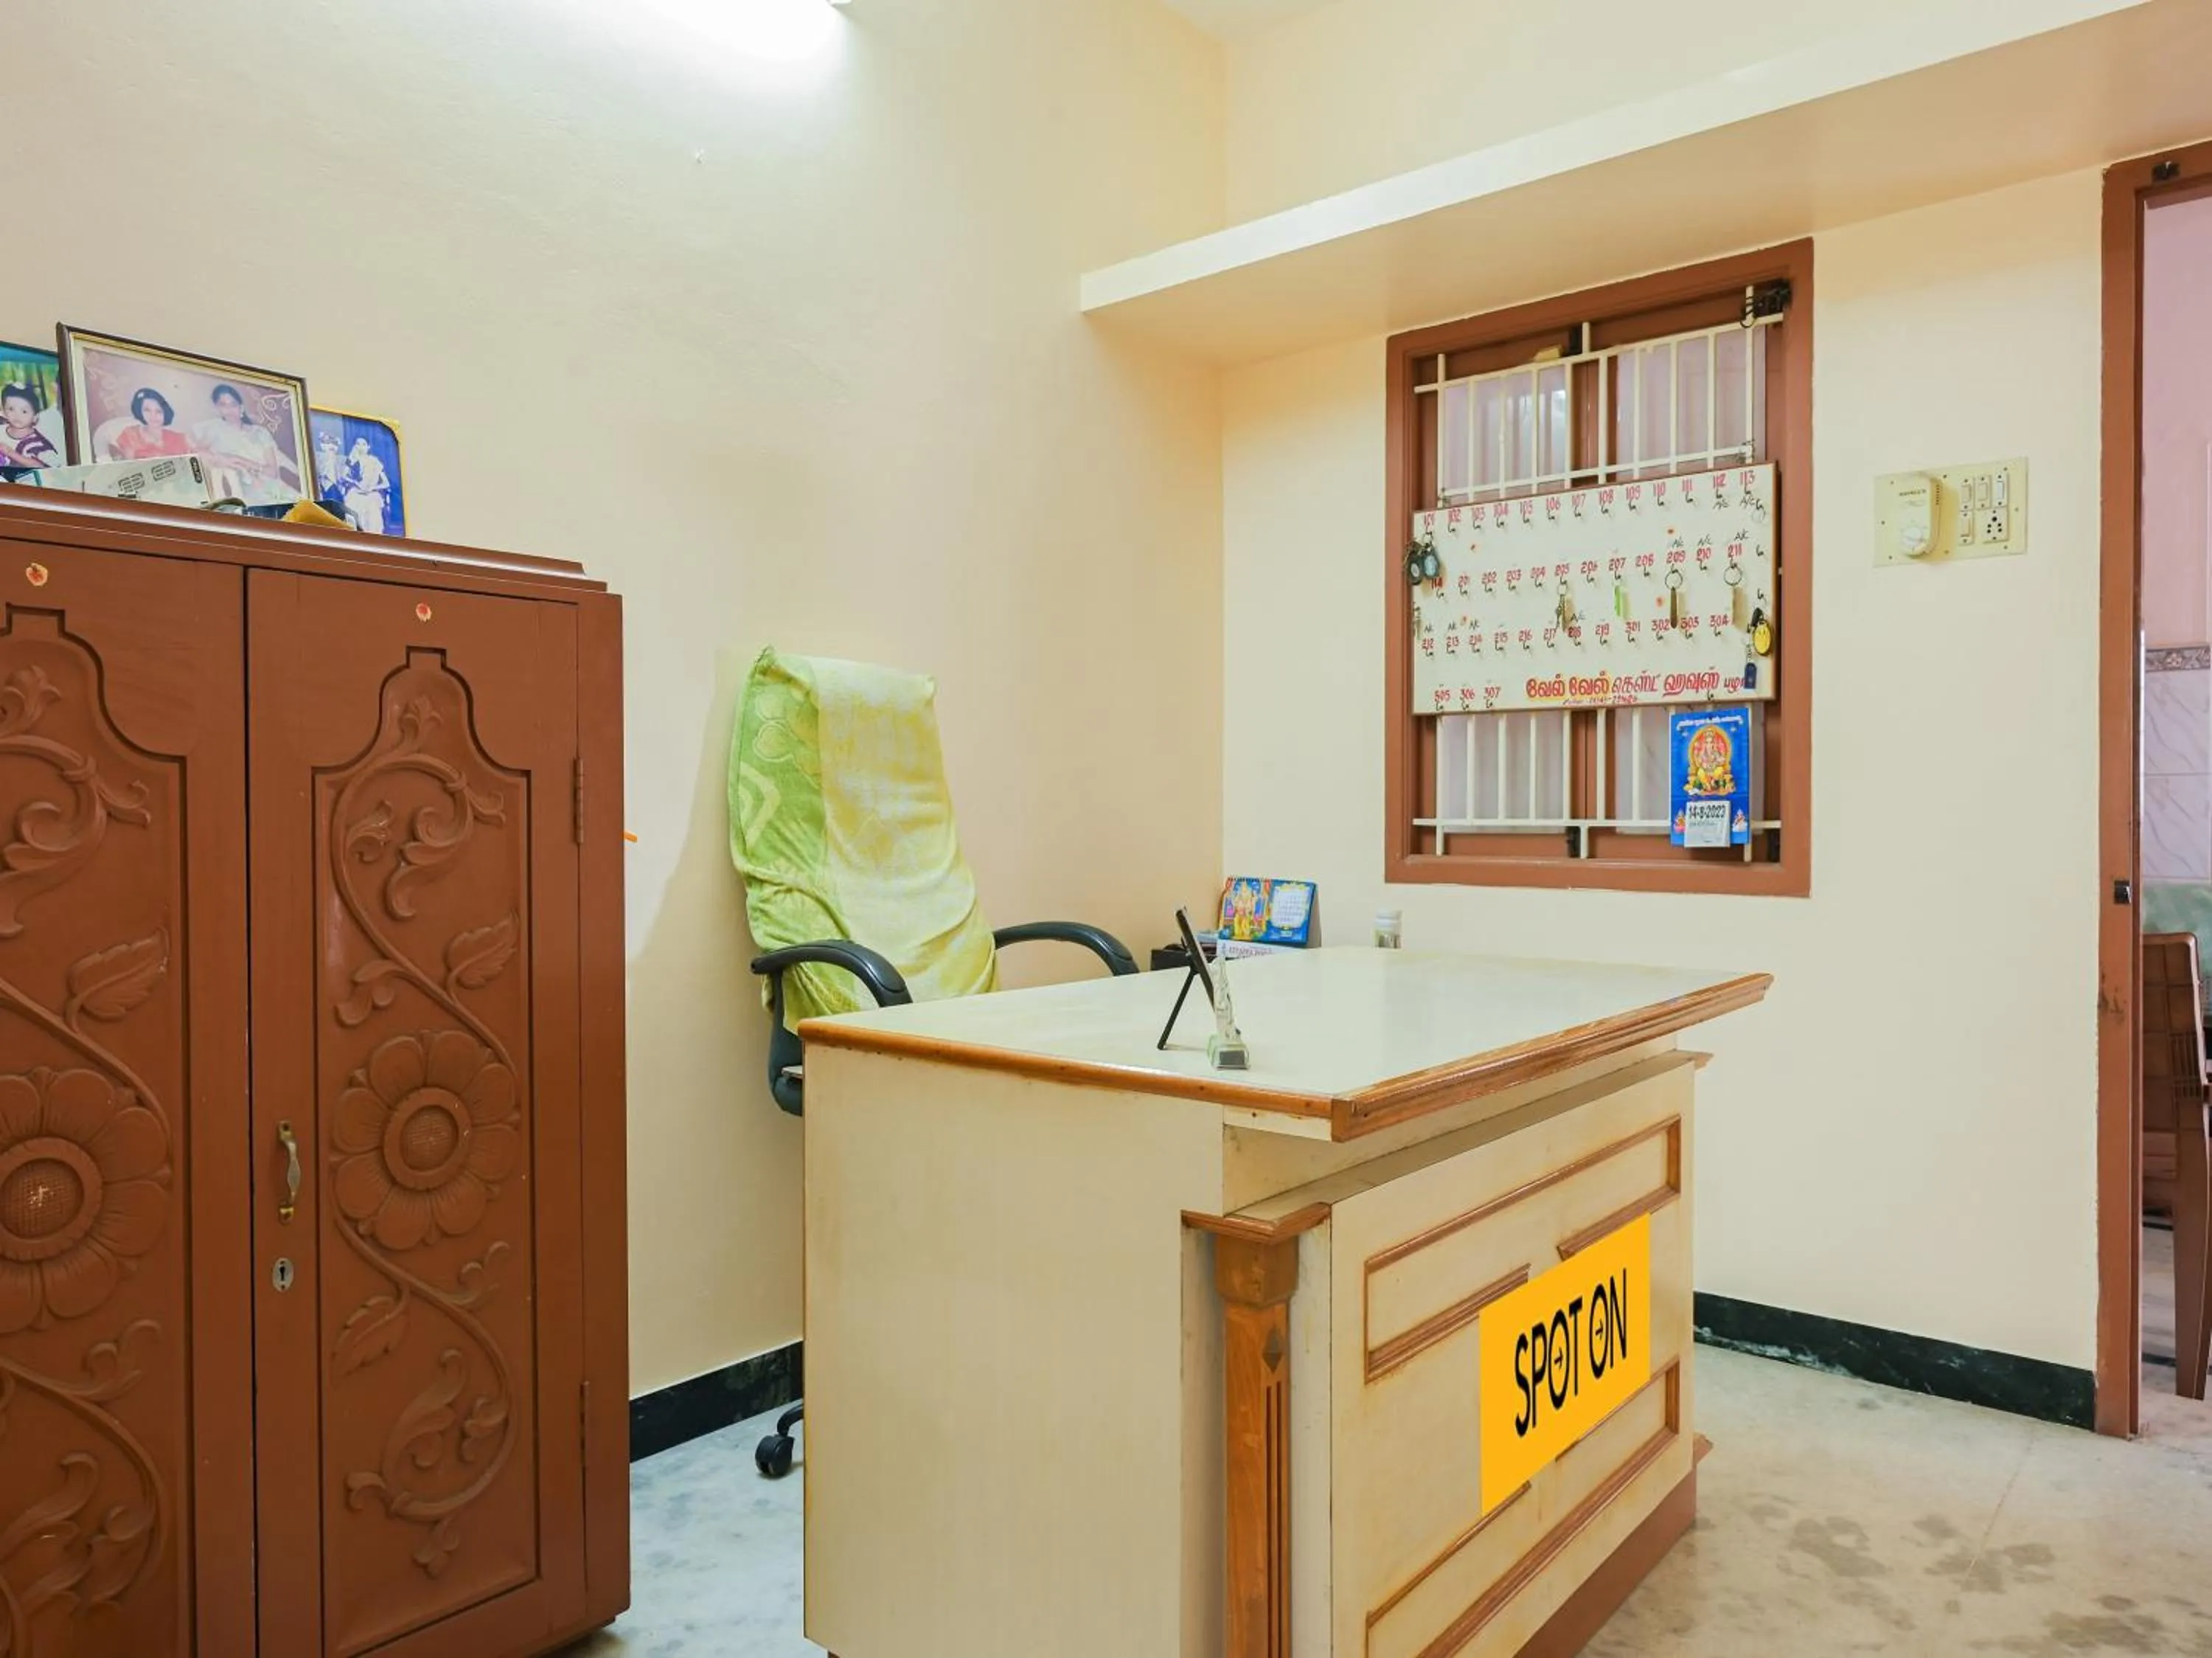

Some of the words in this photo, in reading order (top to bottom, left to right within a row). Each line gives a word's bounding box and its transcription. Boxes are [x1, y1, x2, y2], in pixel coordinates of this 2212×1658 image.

[1447, 509, 1461, 523] 102
[1471, 507, 1485, 521] 103
[1494, 503, 1509, 517] 104
[1520, 500, 1533, 515] 105
[1545, 498, 1561, 511] 106
[1572, 494, 1586, 507] 107
[1599, 489, 1613, 504] 108
[1626, 485, 1641, 500] 109
[1653, 481, 1666, 497] 110
[1682, 478, 1692, 492] 111
[1713, 474, 1726, 489] 112
[1740, 470, 1755, 485] 113
[1482, 571, 1497, 584] 202
[1506, 569, 1521, 582] 203
[1555, 563, 1570, 576] 205
[1580, 561, 1598, 574] 206
[1608, 558, 1626, 571] 207
[1666, 550, 1686, 564] 209
[1696, 547, 1711, 561] 210
[1728, 543, 1742, 558] 211
[1422, 637, 1434, 650] 212
[1446, 637, 1460, 648] 213
[1495, 631, 1508, 644] 215
[1519, 629, 1533, 642] 216
[1543, 627, 1557, 641] 217
[1595, 624, 1610, 637] 219
[1625, 621, 1641, 634] 301
[1652, 618, 1670, 631] 302
[1680, 617, 1700, 630] 303
[1710, 614, 1730, 628] 304
[1460, 687, 1475, 701] 306
[1484, 686, 1500, 699] 307
[1514, 1295, 1583, 1437] SPOT
[1589, 1267, 1627, 1379] ON
